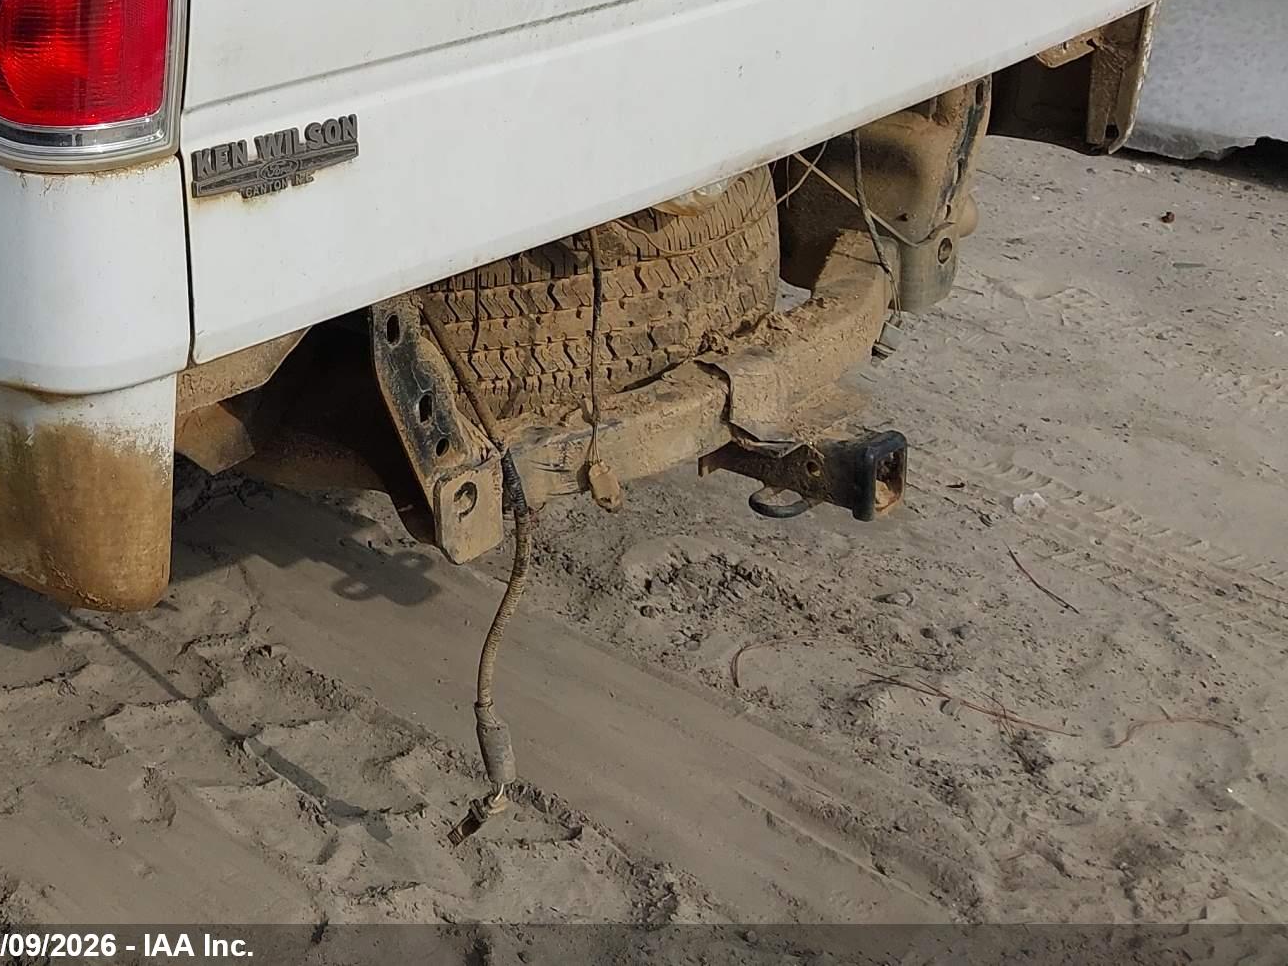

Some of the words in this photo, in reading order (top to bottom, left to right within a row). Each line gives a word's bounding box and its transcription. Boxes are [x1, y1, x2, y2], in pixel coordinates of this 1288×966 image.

[191, 139, 249, 180] KEN
[254, 114, 358, 161] WILSON
[242, 177, 289, 198] CANTON
